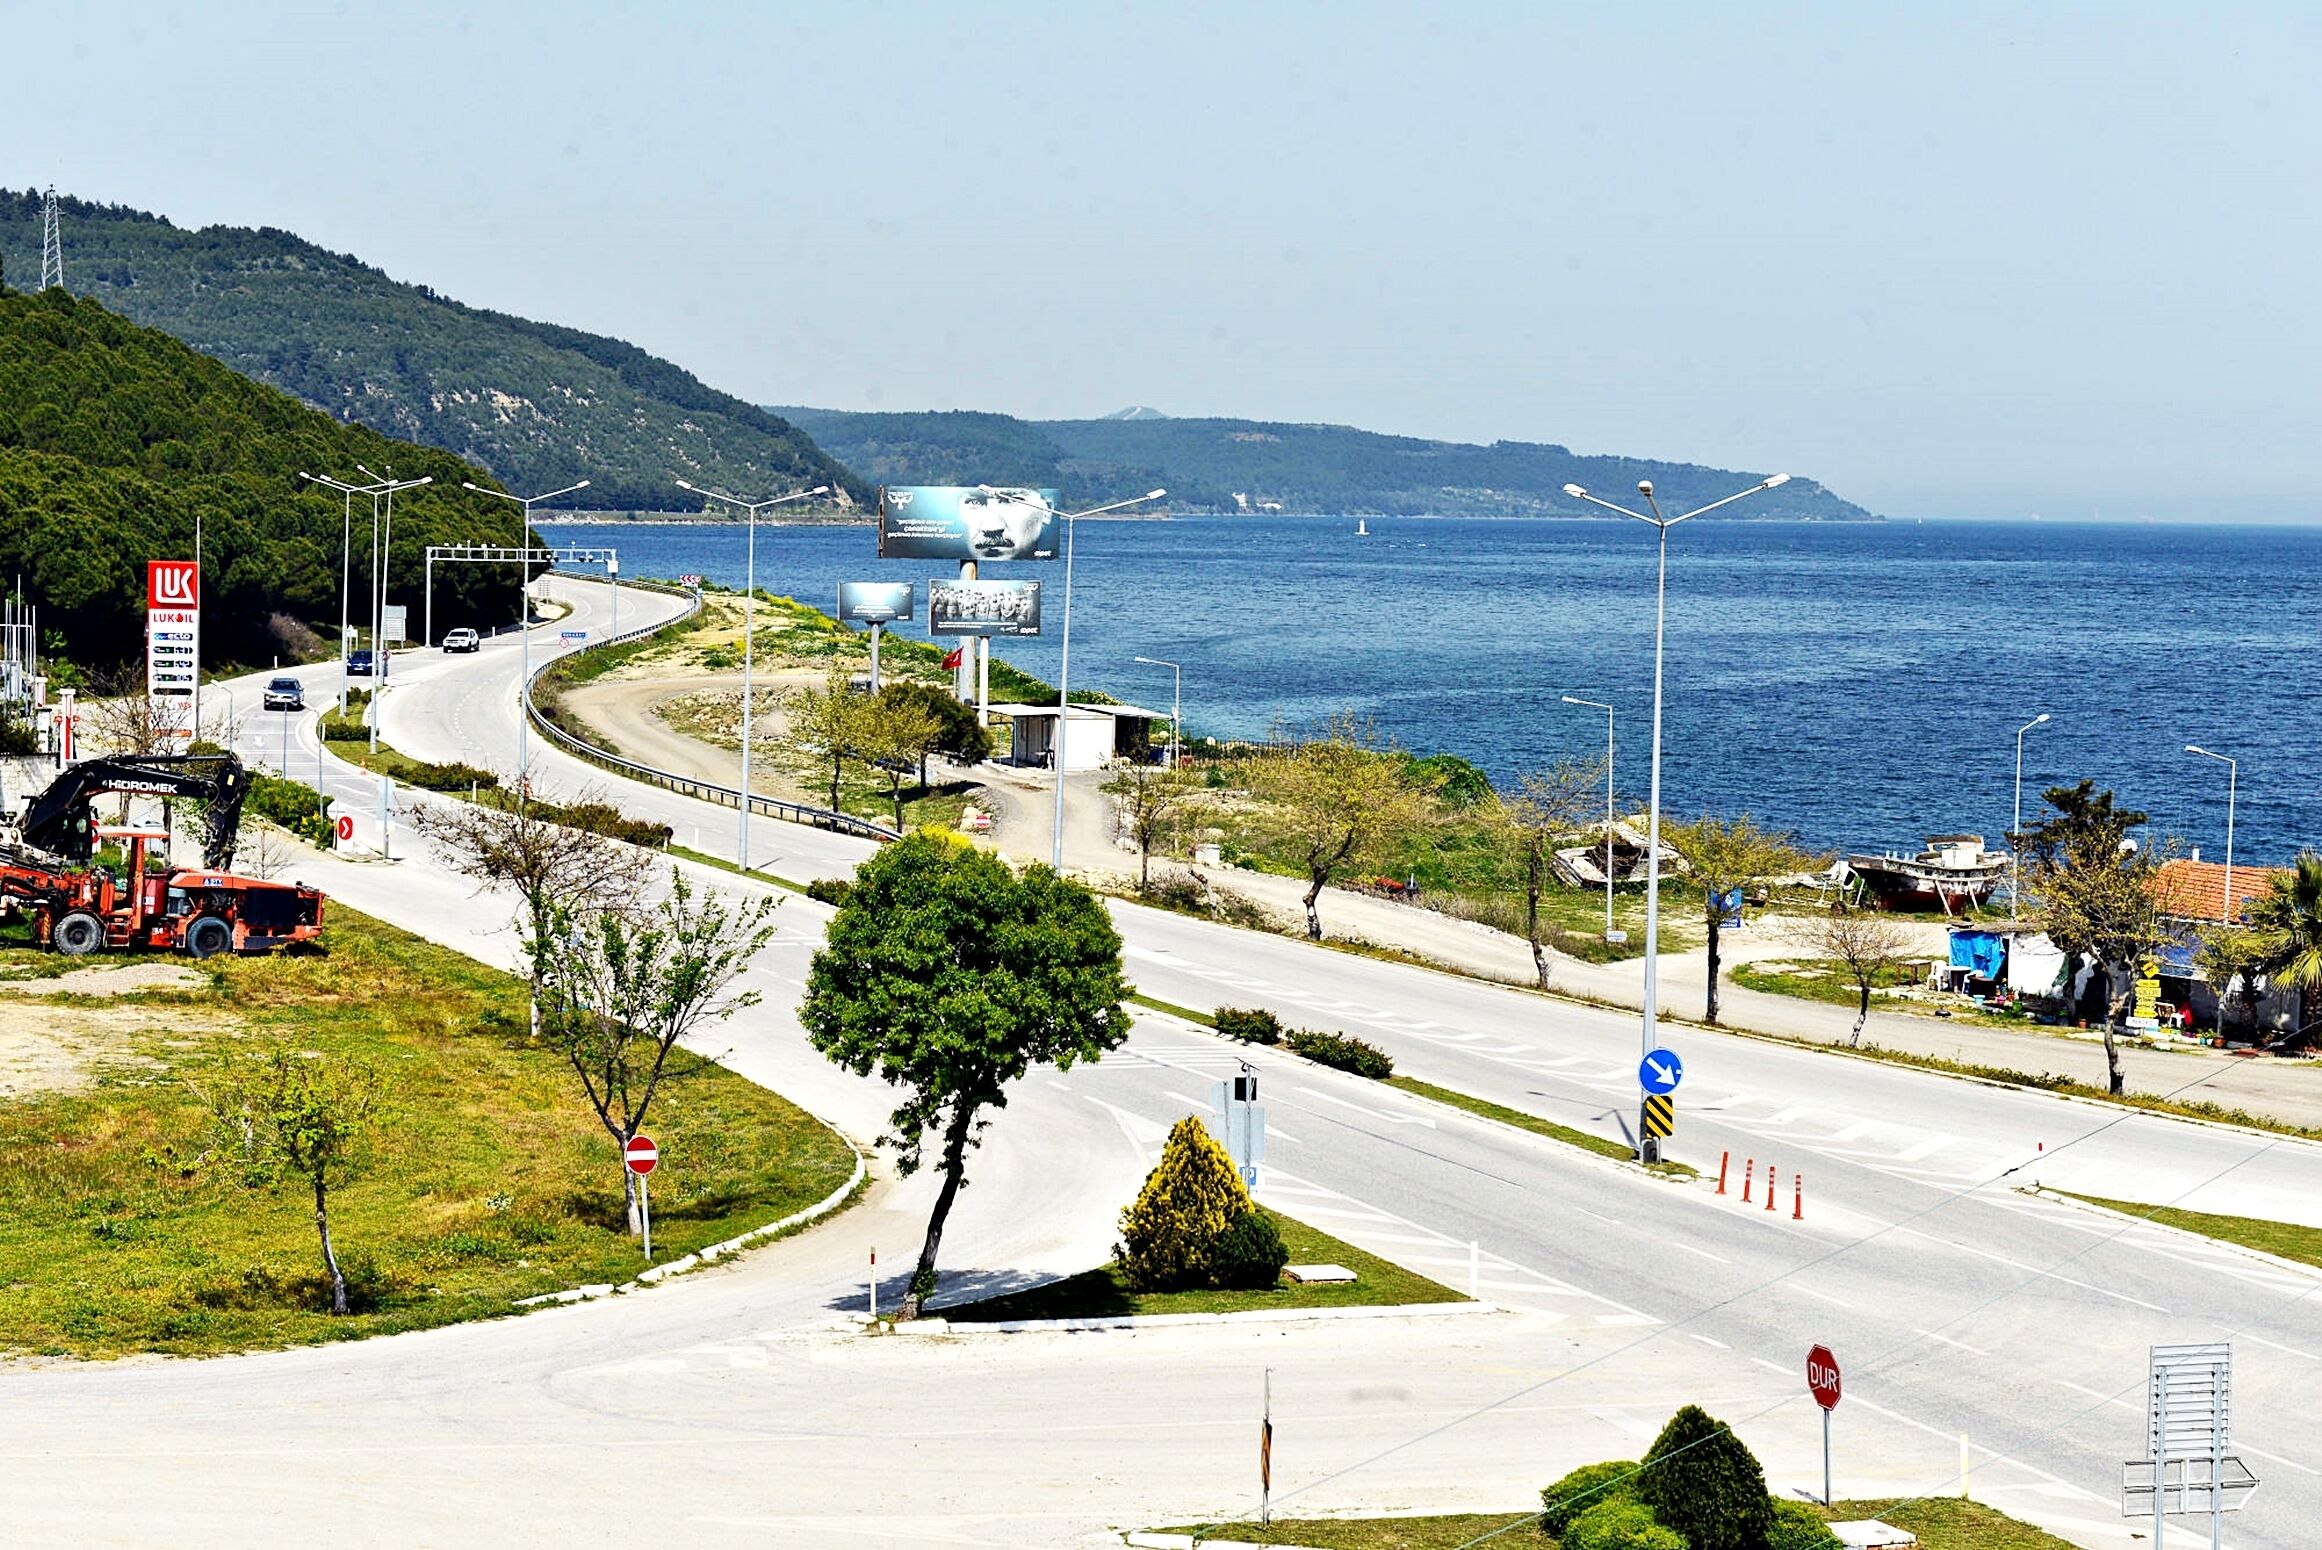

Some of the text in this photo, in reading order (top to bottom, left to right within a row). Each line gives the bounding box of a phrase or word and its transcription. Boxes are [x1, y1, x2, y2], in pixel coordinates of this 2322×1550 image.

[155, 567, 195, 605] LUK
[153, 612, 193, 623] LUKOIL
[1809, 1361, 1838, 1392] DUR
